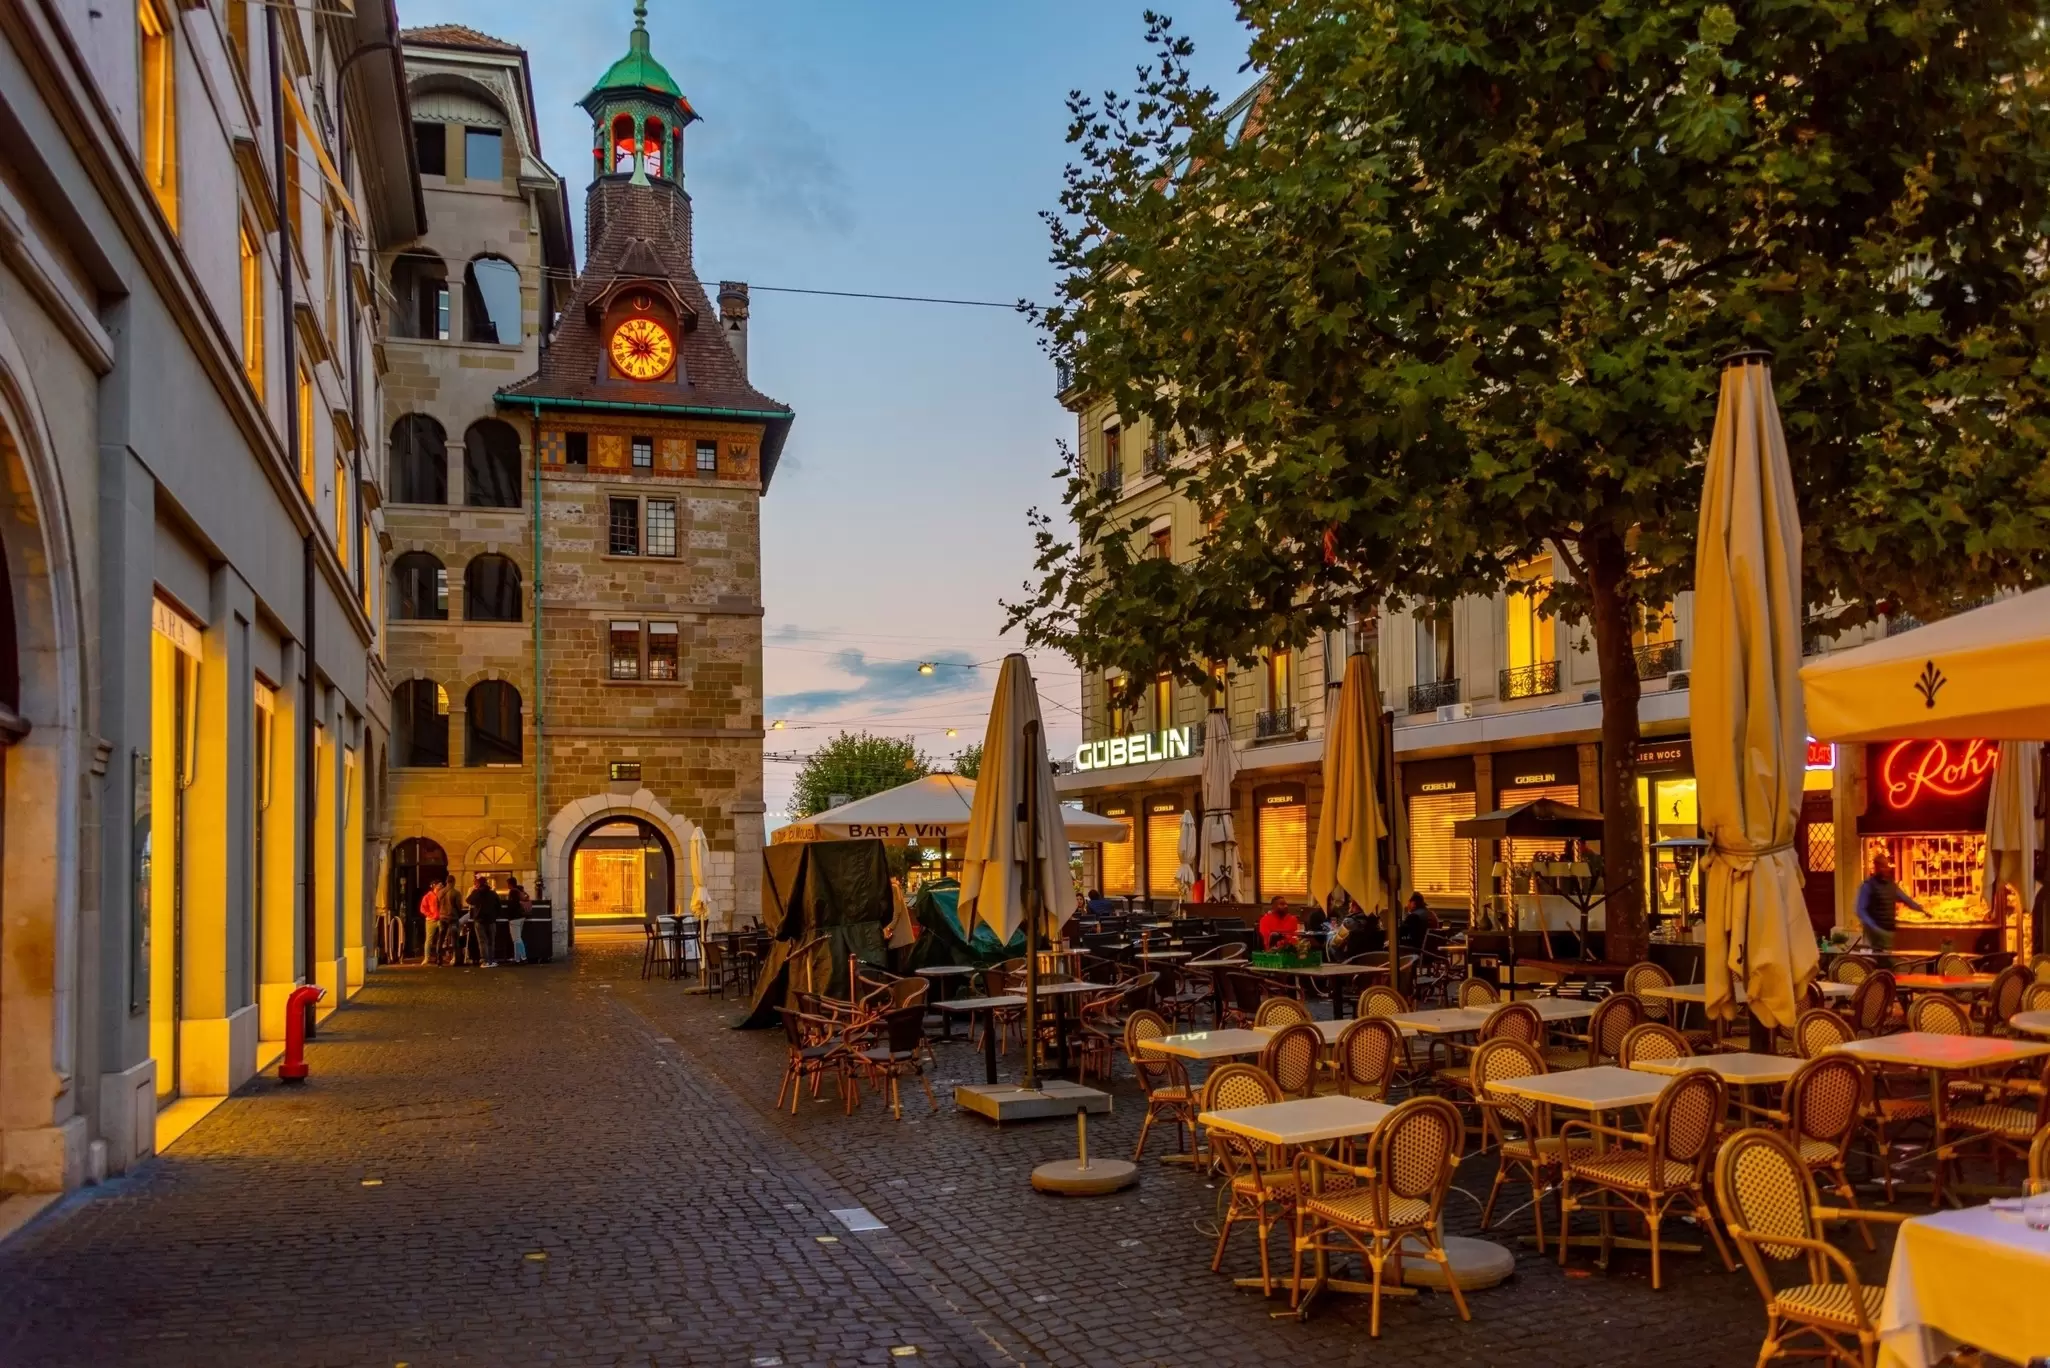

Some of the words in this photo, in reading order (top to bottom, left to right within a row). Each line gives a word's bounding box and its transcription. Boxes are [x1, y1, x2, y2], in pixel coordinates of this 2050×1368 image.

[153, 606, 186, 646] ARA
[1075, 726, 1190, 771] GÜBELIN
[1656, 750, 1681, 760] WOCS
[848, 824, 890, 838] BAR
[915, 823, 947, 837] VIN
